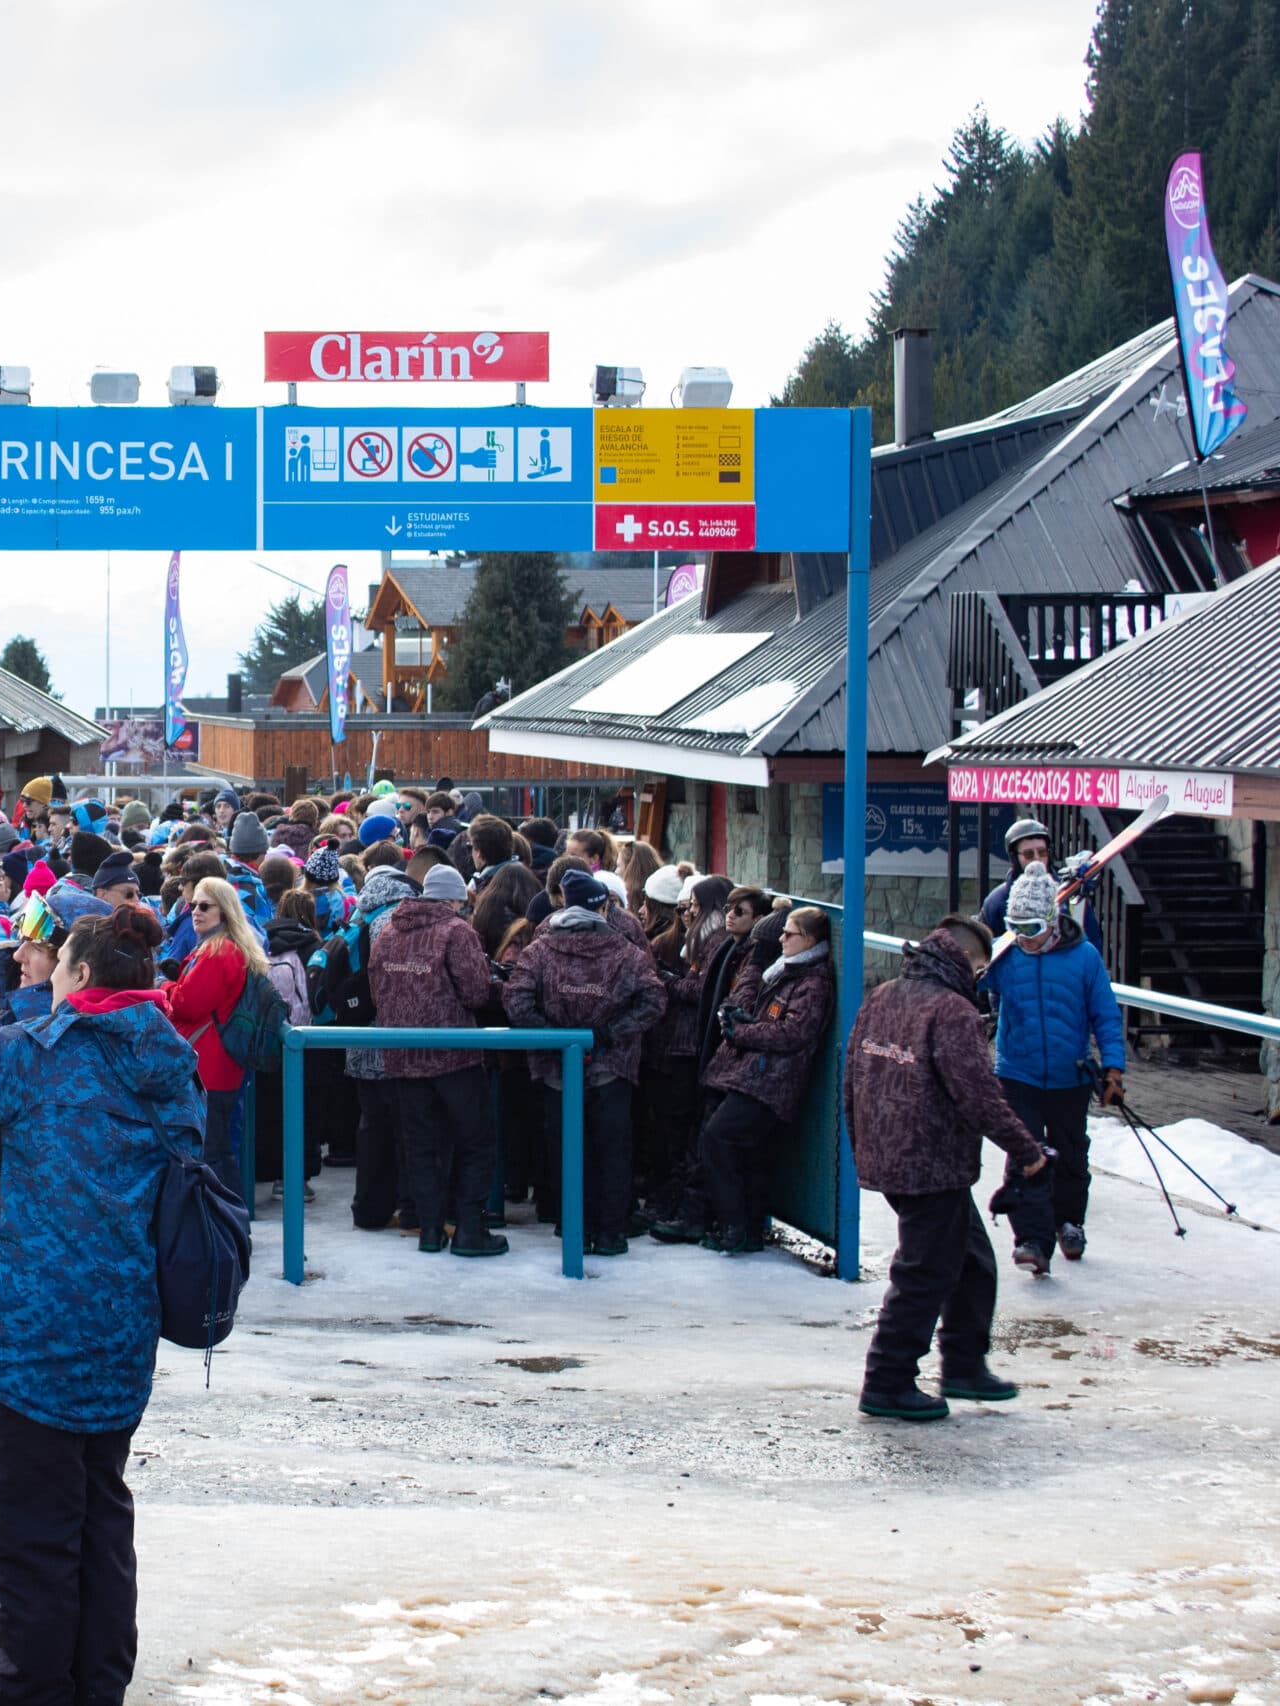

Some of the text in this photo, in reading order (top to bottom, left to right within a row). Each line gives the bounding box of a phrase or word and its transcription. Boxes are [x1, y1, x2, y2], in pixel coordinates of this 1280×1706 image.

[309, 333, 473, 381] Clarín
[600, 425, 644, 433] ESCALA DE
[600, 434, 642, 442] RIESGO DE
[600, 443, 649, 451] AVALANCHA
[225, 441, 233, 481] I
[99, 506, 114, 515] 955
[116, 506, 141, 516] pax/h
[408, 512, 470, 521] ESTUDIANTES
[648, 520, 694, 537] S.O.S.
[698, 527, 736, 537] 4409040
[950, 771, 1118, 805] ROPA Y ACCESORIOS DE SKI
[1125, 775, 1227, 810] Alquiler Aluguel
[902, 818, 924, 834] 15%
